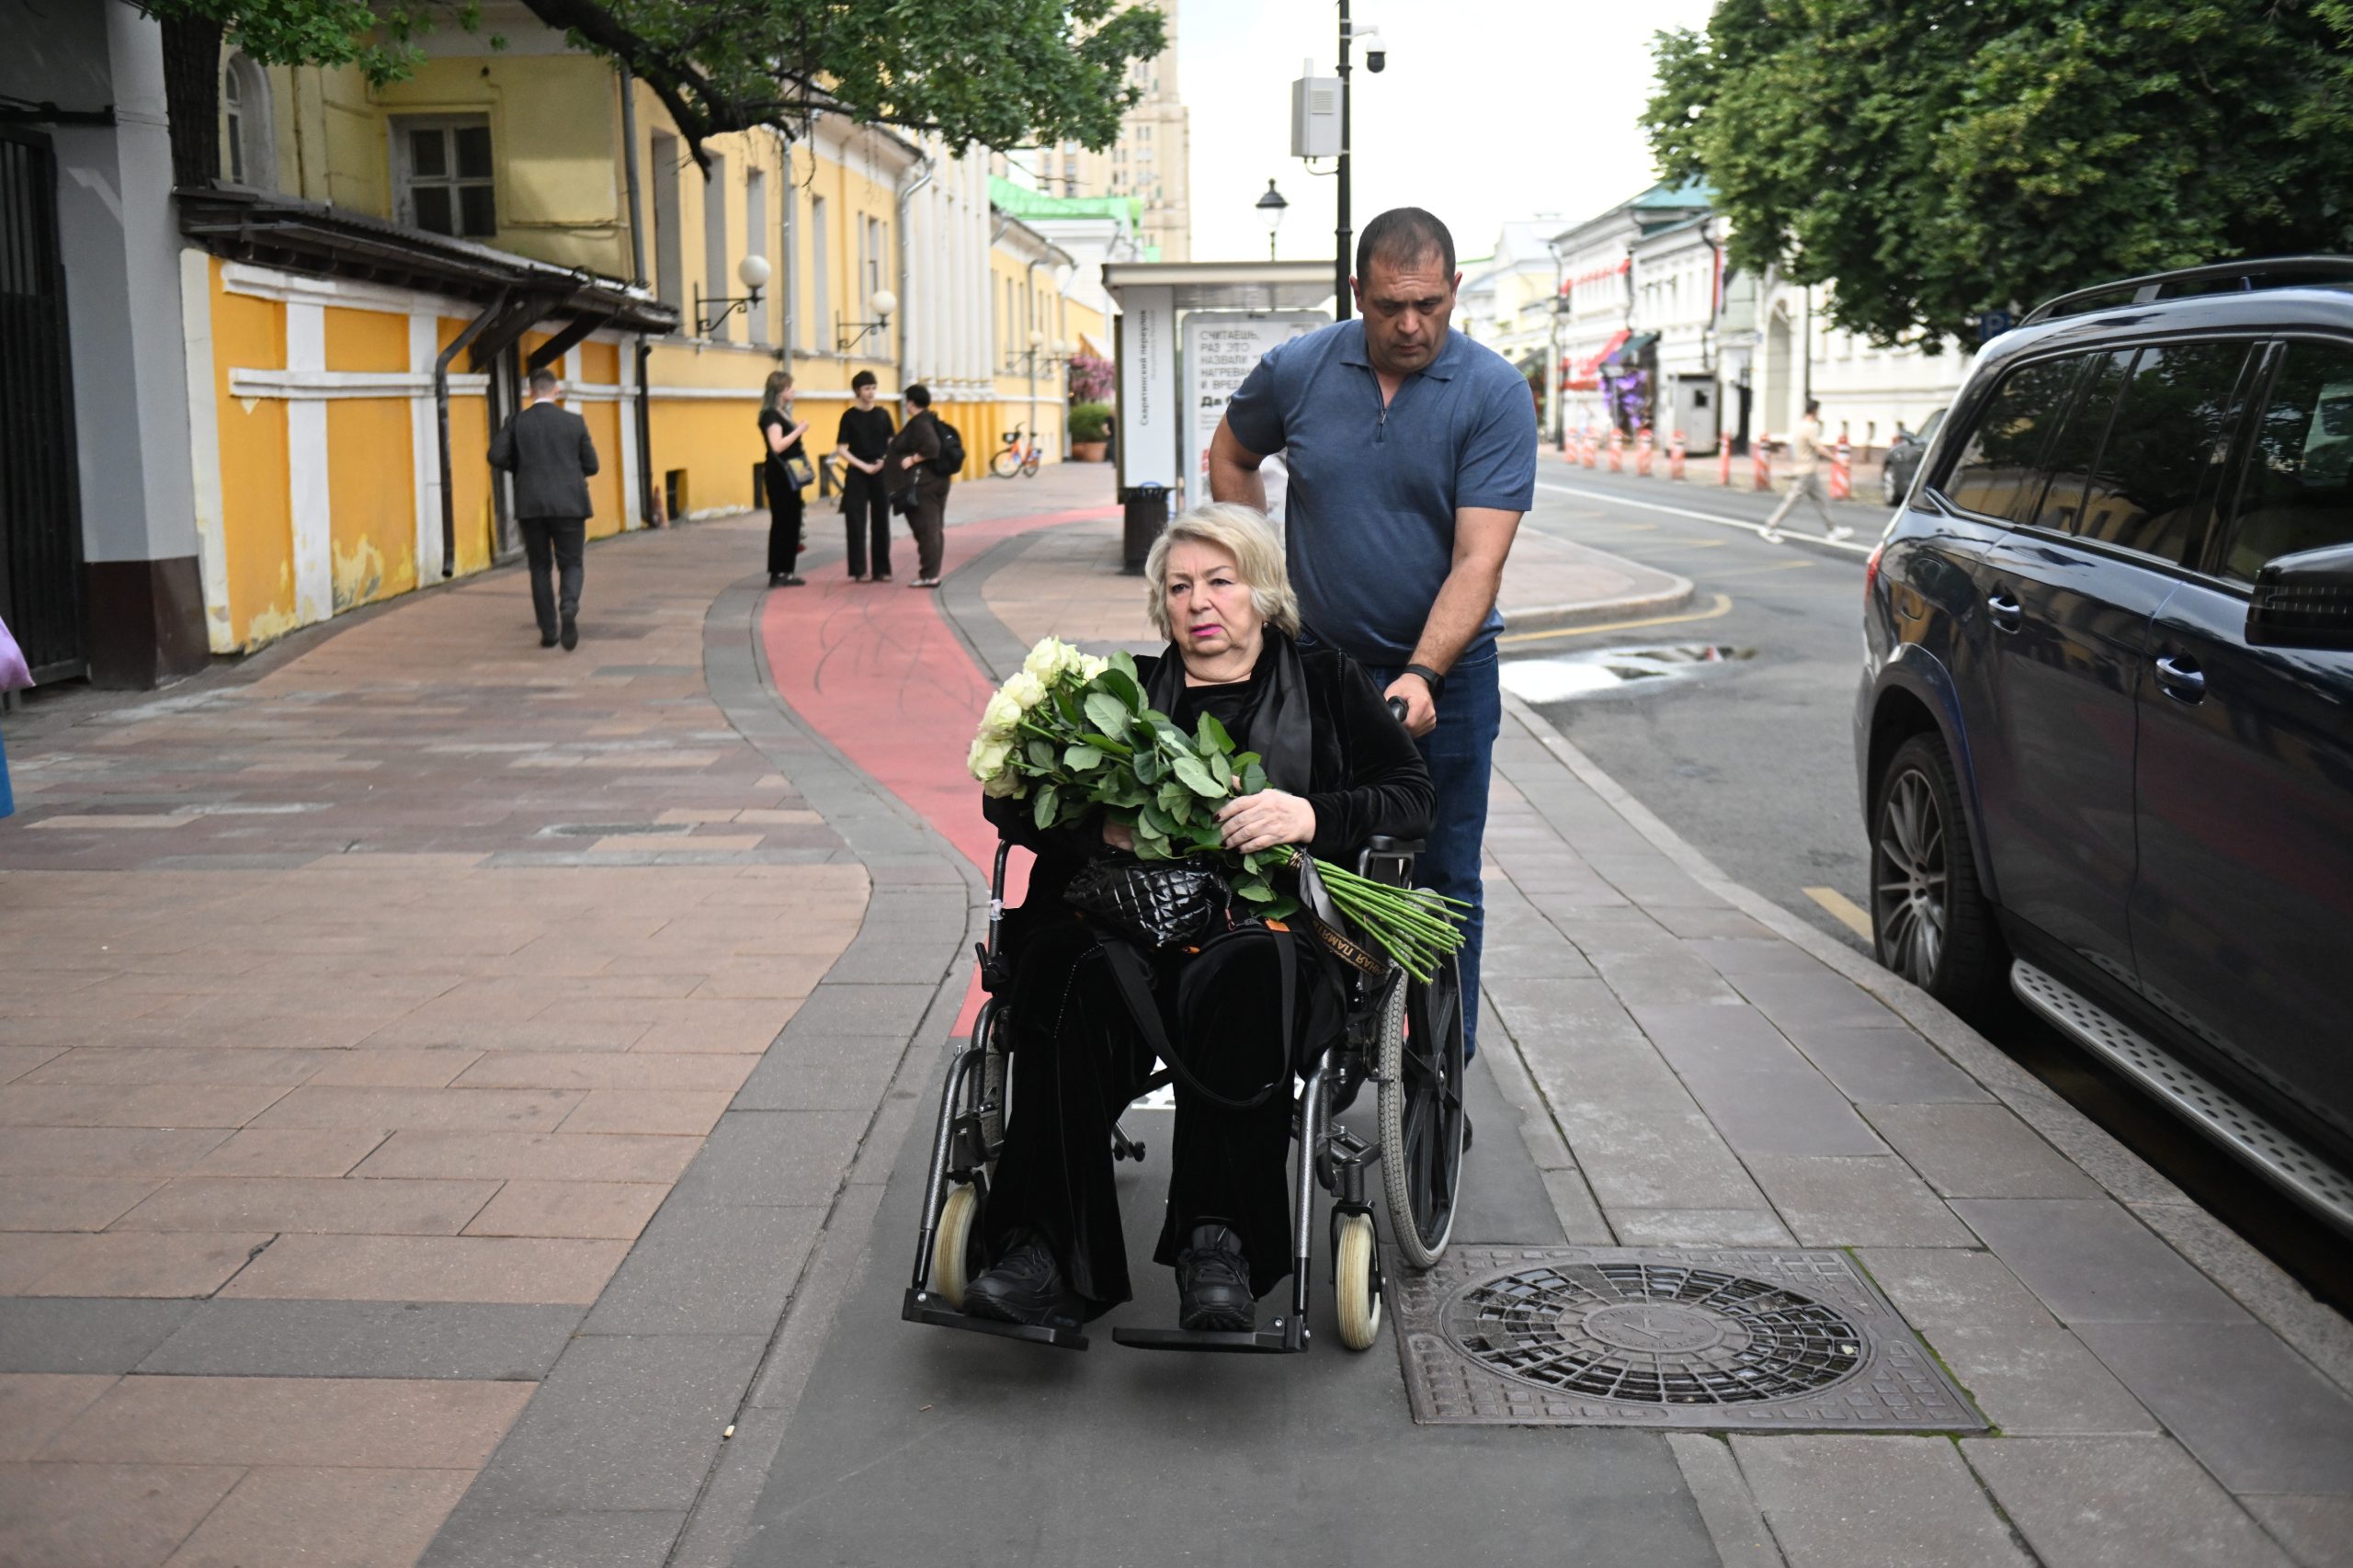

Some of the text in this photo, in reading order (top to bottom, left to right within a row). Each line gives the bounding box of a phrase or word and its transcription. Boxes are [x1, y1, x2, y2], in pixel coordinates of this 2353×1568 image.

[1200, 343, 1250, 352] РАЗ ЭТО
[1200, 355, 1247, 365] НАЗВАЛИ
[1139, 309, 1149, 426] Скарятинский переулок
